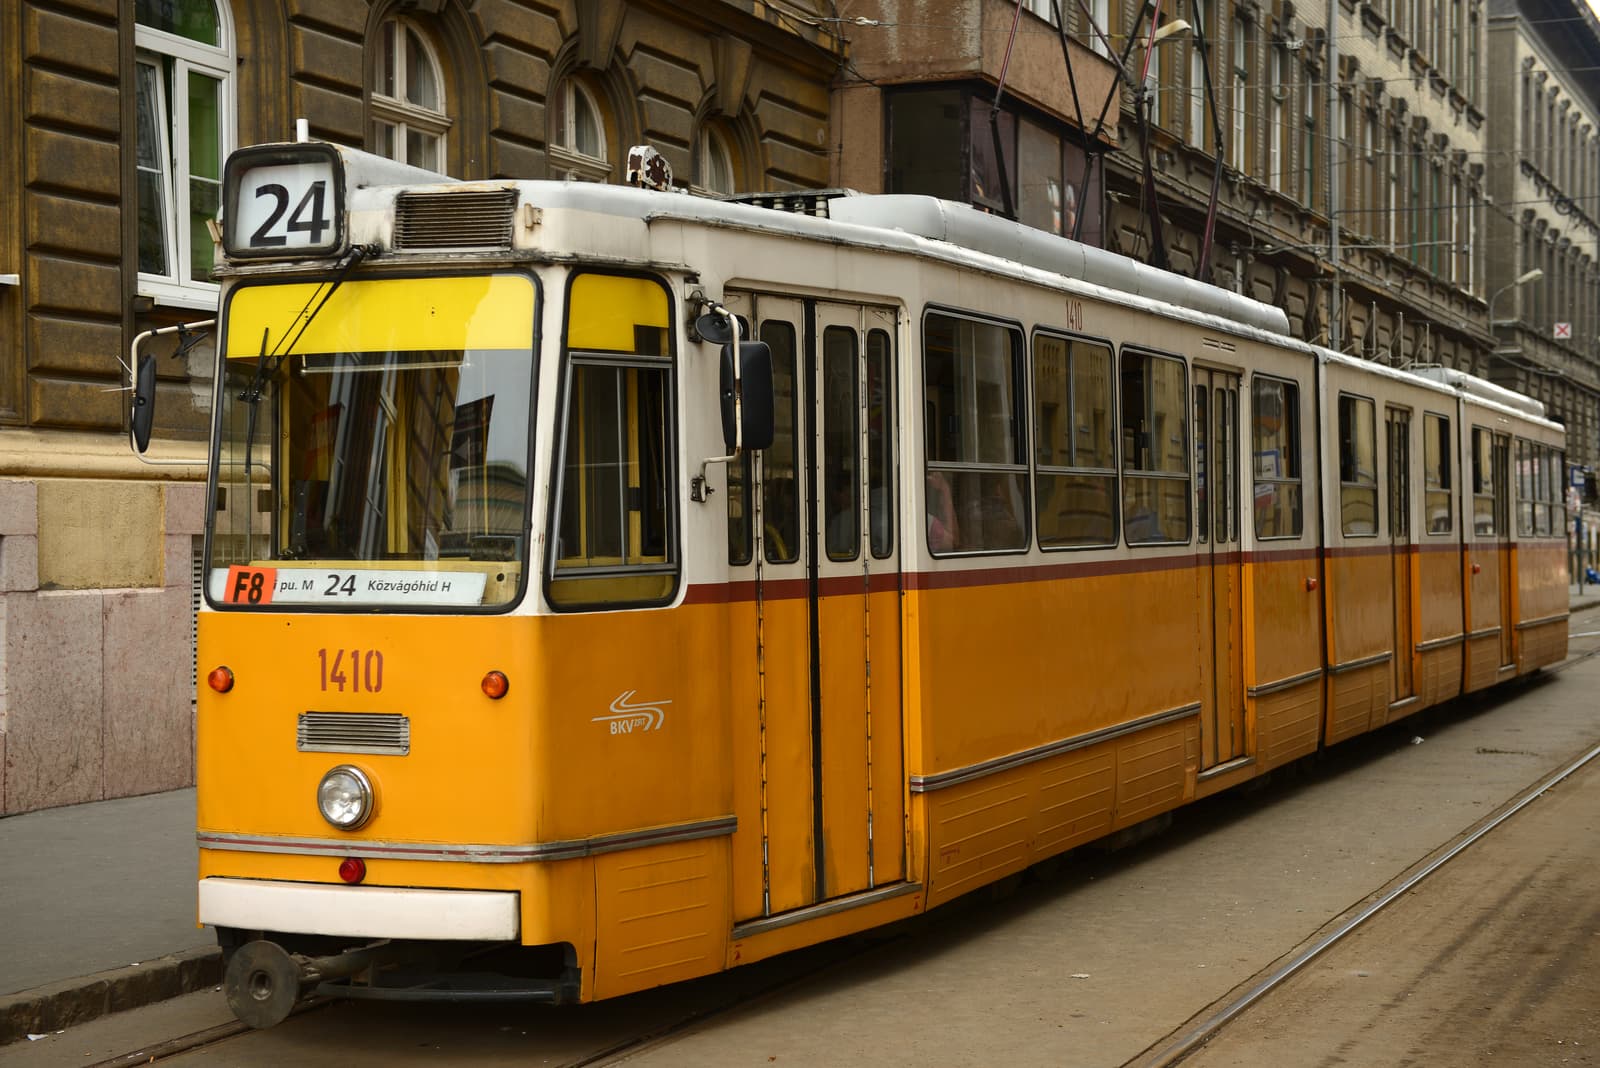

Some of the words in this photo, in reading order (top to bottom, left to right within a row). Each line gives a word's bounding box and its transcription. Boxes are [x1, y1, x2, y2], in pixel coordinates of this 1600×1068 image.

[250, 180, 330, 248] 24
[1065, 299, 1083, 331] 1410
[232, 571, 265, 605] F8
[280, 581, 298, 593] pu.
[302, 579, 314, 591] M
[323, 574, 357, 597] 24
[441, 581, 452, 592] H
[318, 648, 384, 693] 1410
[610, 719, 634, 735] BKV
